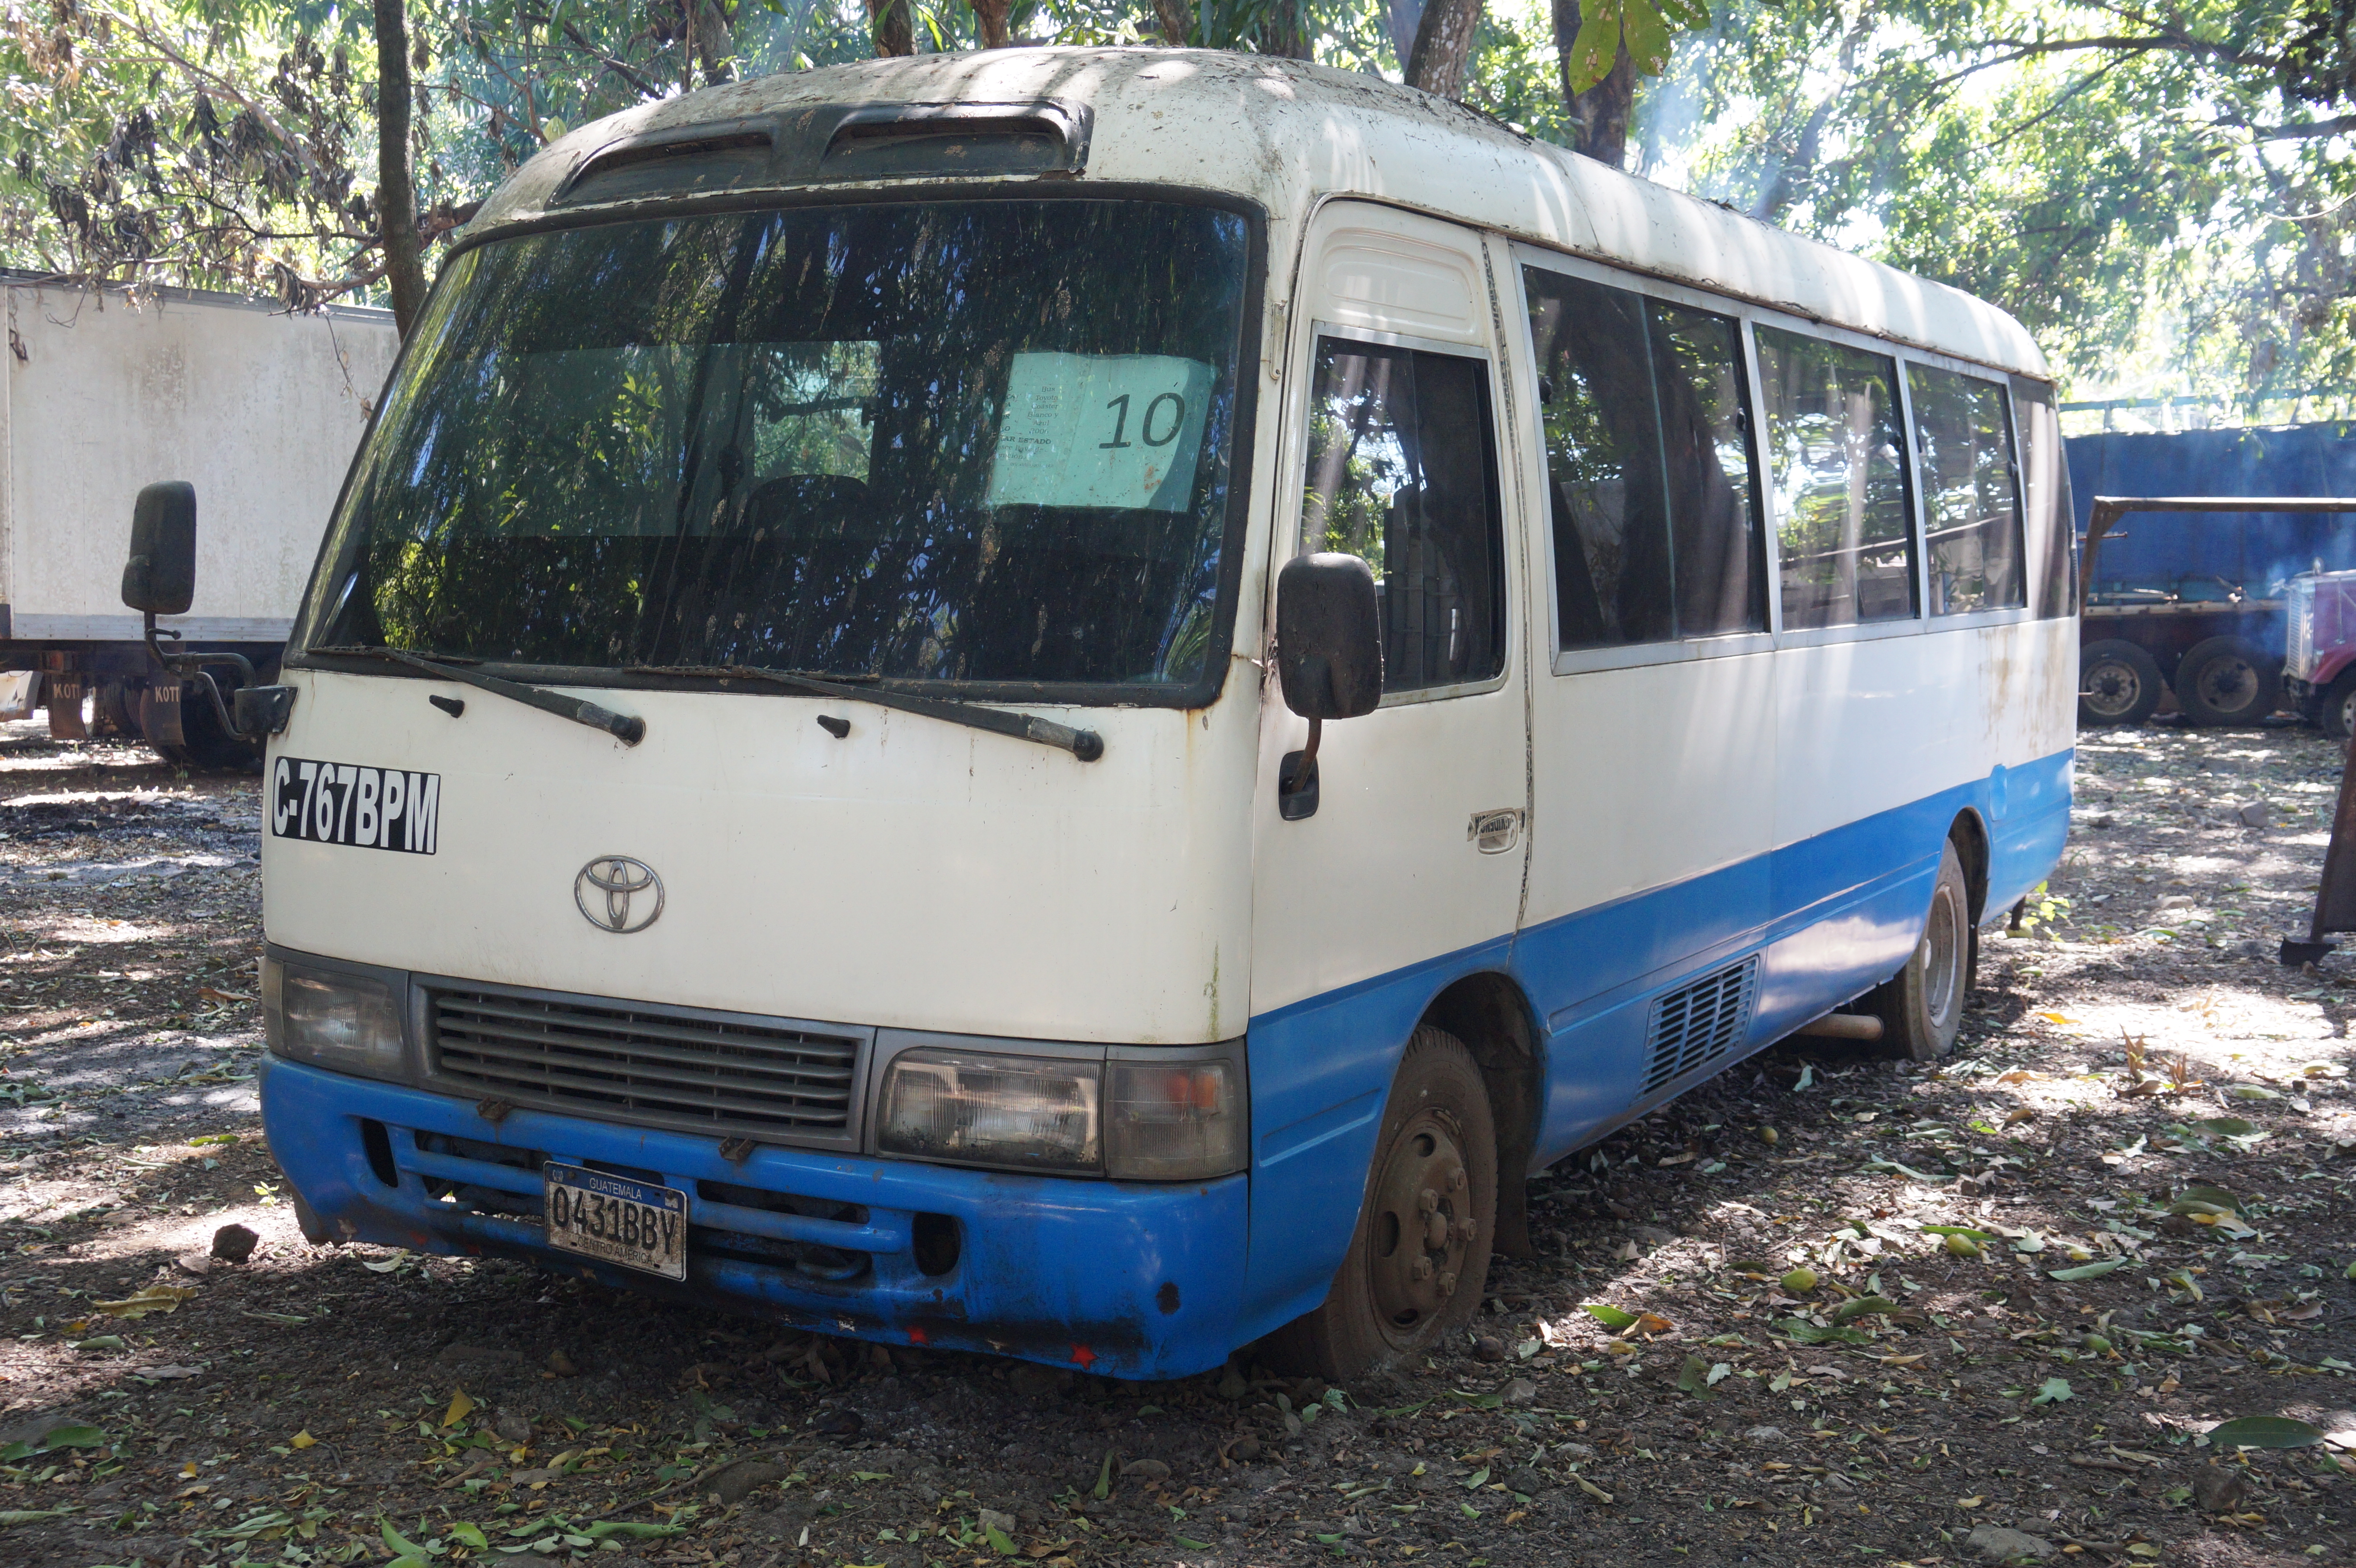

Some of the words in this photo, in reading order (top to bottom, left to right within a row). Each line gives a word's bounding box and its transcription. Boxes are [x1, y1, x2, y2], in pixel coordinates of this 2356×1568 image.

[1099, 392, 1185, 449] 10
[155, 686, 179, 702] KOTT
[273, 758, 440, 854] C-767BPM
[589, 1177, 642, 1201] GUATEMALA
[578, 1236, 612, 1255] CENTRO
